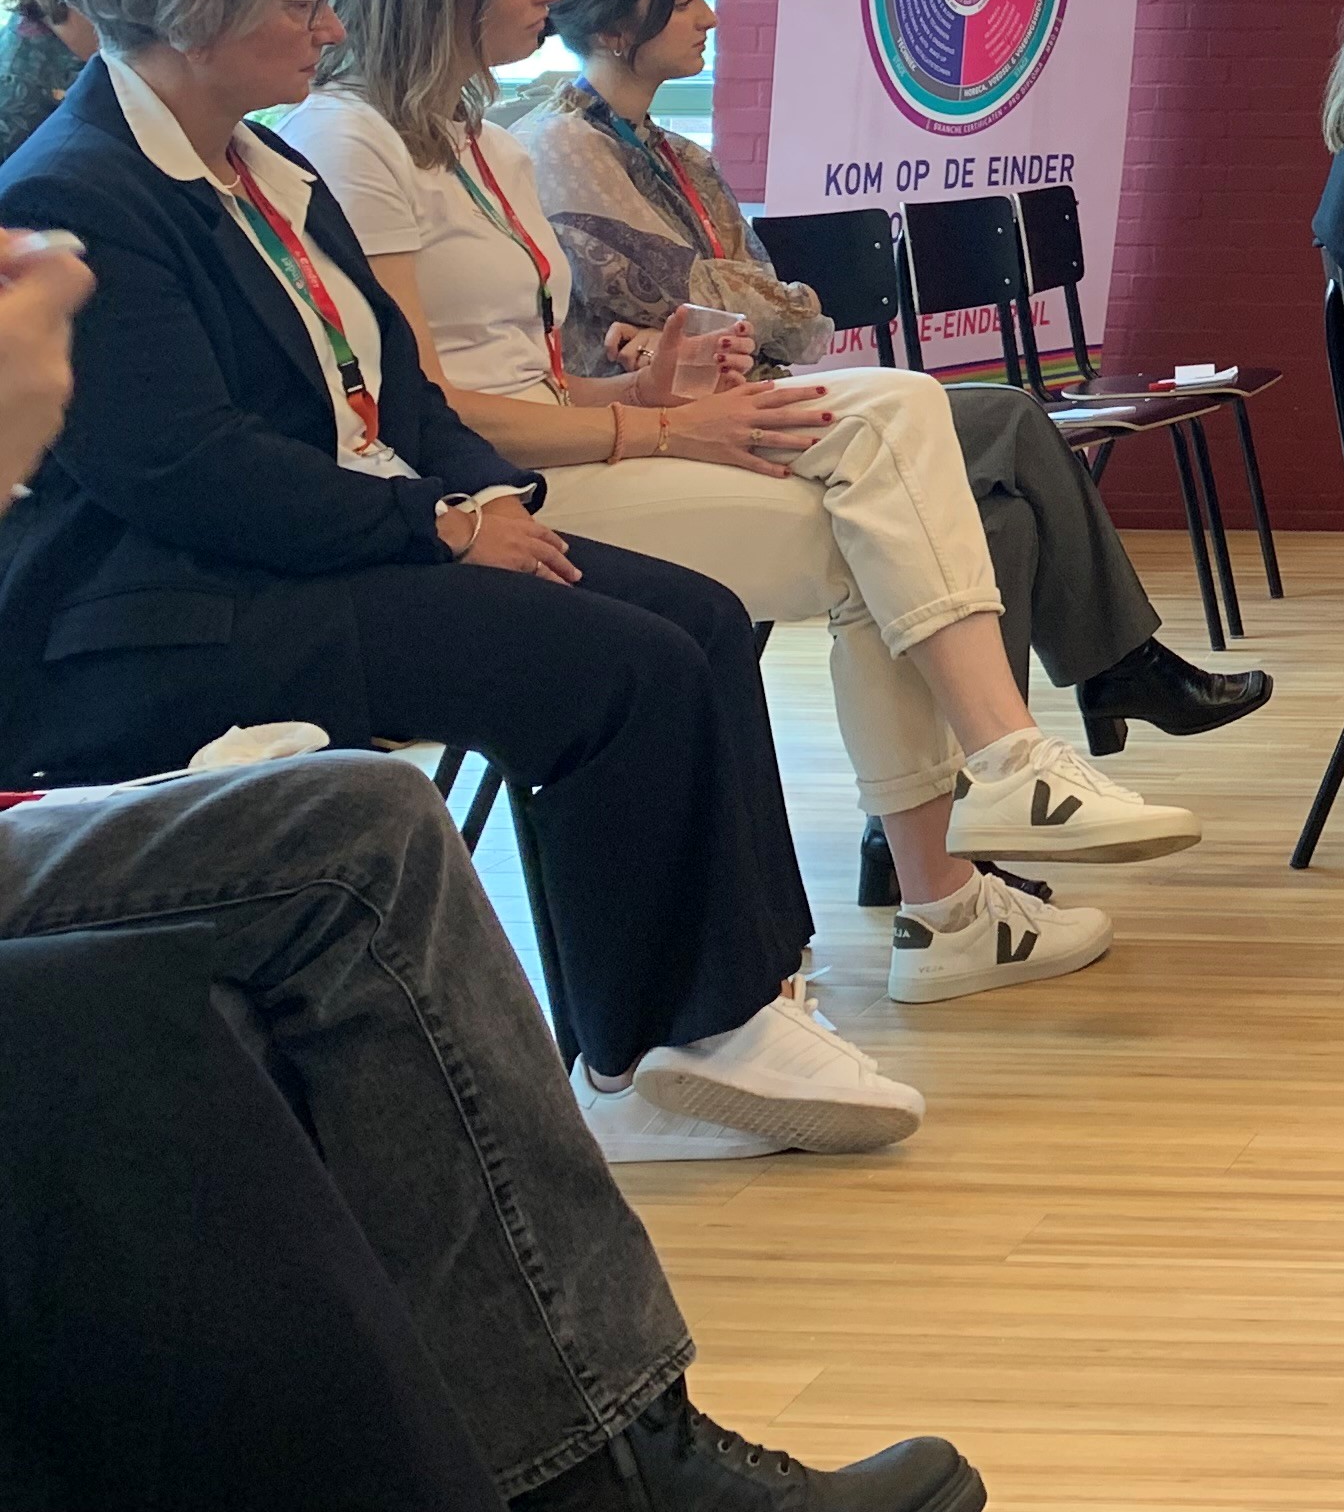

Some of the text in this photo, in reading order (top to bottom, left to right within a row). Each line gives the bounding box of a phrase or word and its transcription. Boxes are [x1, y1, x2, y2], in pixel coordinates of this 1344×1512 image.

[825, 154, 1075, 196] KOM OP DE EINDER
[830, 326, 863, 354] IJK
